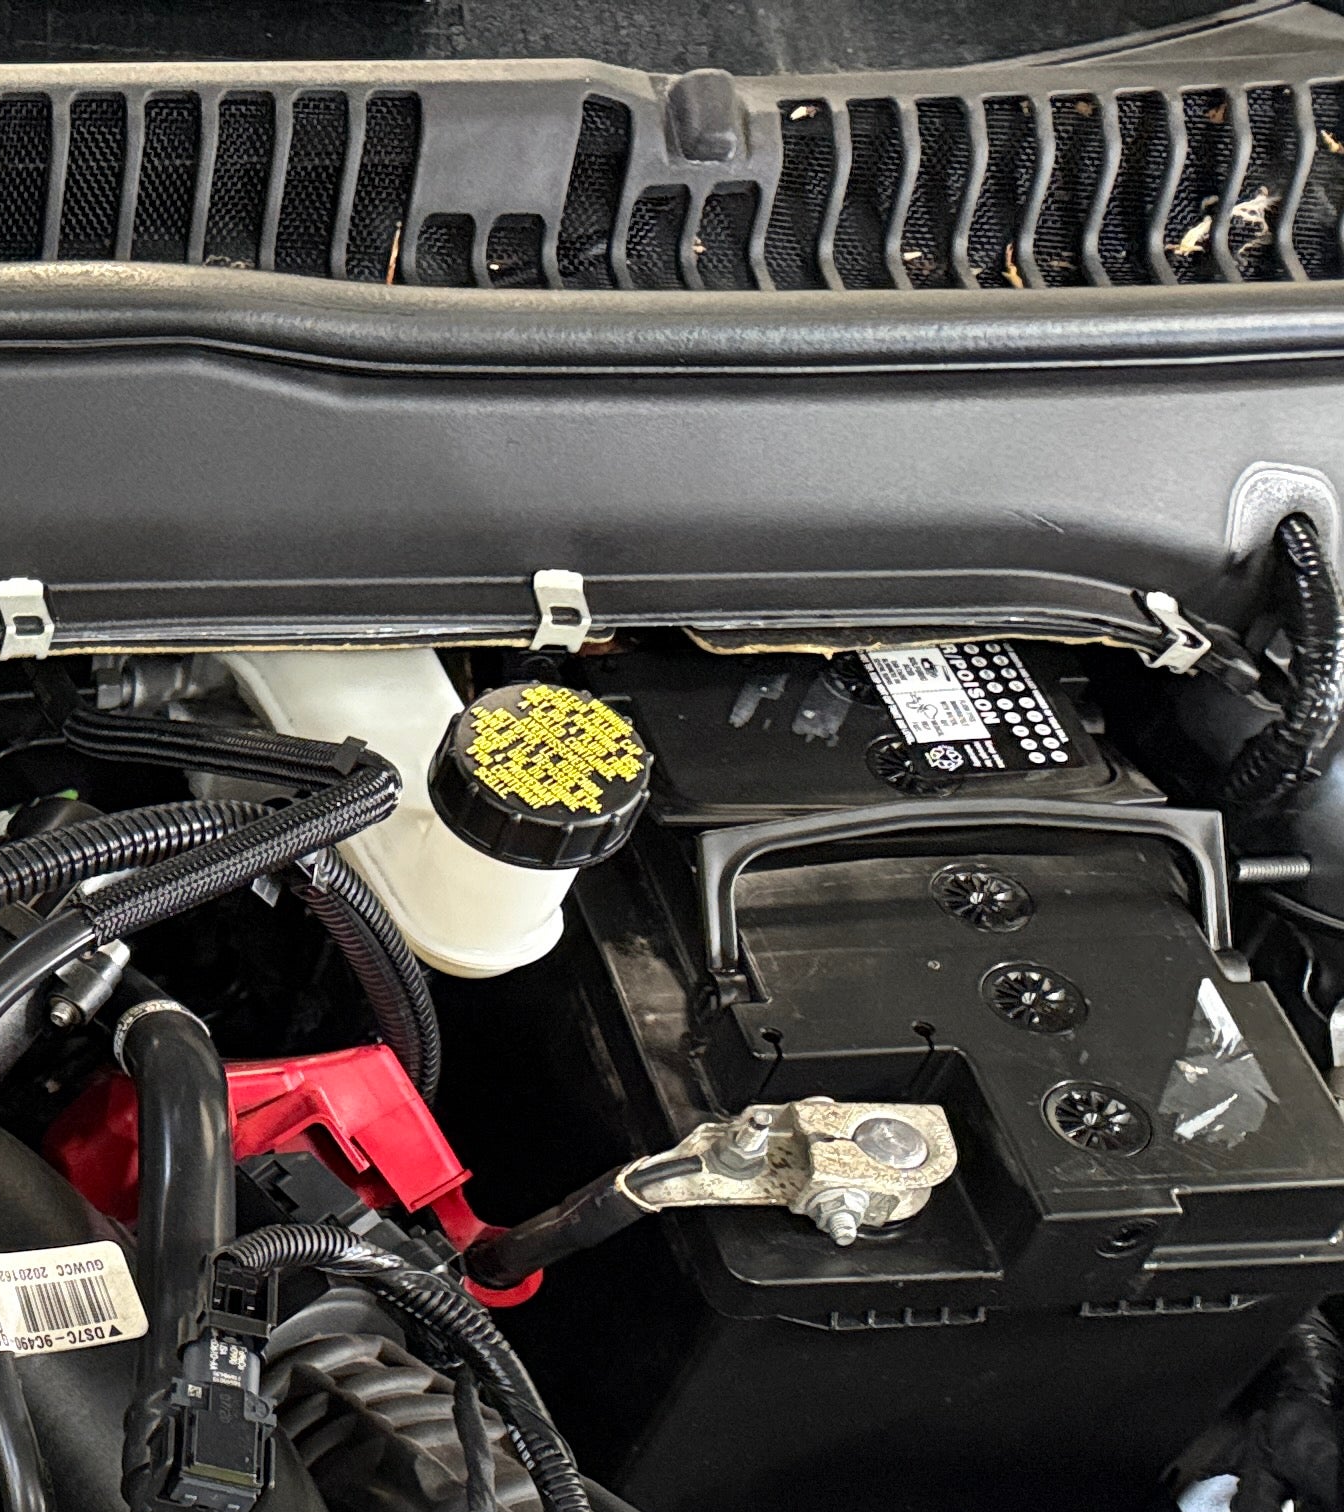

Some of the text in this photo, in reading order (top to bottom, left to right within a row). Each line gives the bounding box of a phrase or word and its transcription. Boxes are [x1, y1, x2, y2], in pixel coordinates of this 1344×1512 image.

[472, 707, 504, 731] AVANT
[528, 709, 565, 737] SEALED
[533, 685, 572, 715] BEFORE
[554, 689, 588, 714] CLEAN
[585, 713, 620, 741] FILLER
[492, 709, 540, 747] NETTOYER
[556, 761, 602, 798] BOUCHON
[520, 689, 550, 710] ONLY
[576, 734, 607, 757] FLUID
[604, 757, 636, 781] FROM
[466, 746, 544, 808] D'UN CONTENANT
[471, 721, 509, 750] PLOYER
[543, 780, 582, 811] LIQUIDE
[503, 761, 558, 805] PROVENANT
[56, 1259, 105, 1276] GUWCC
